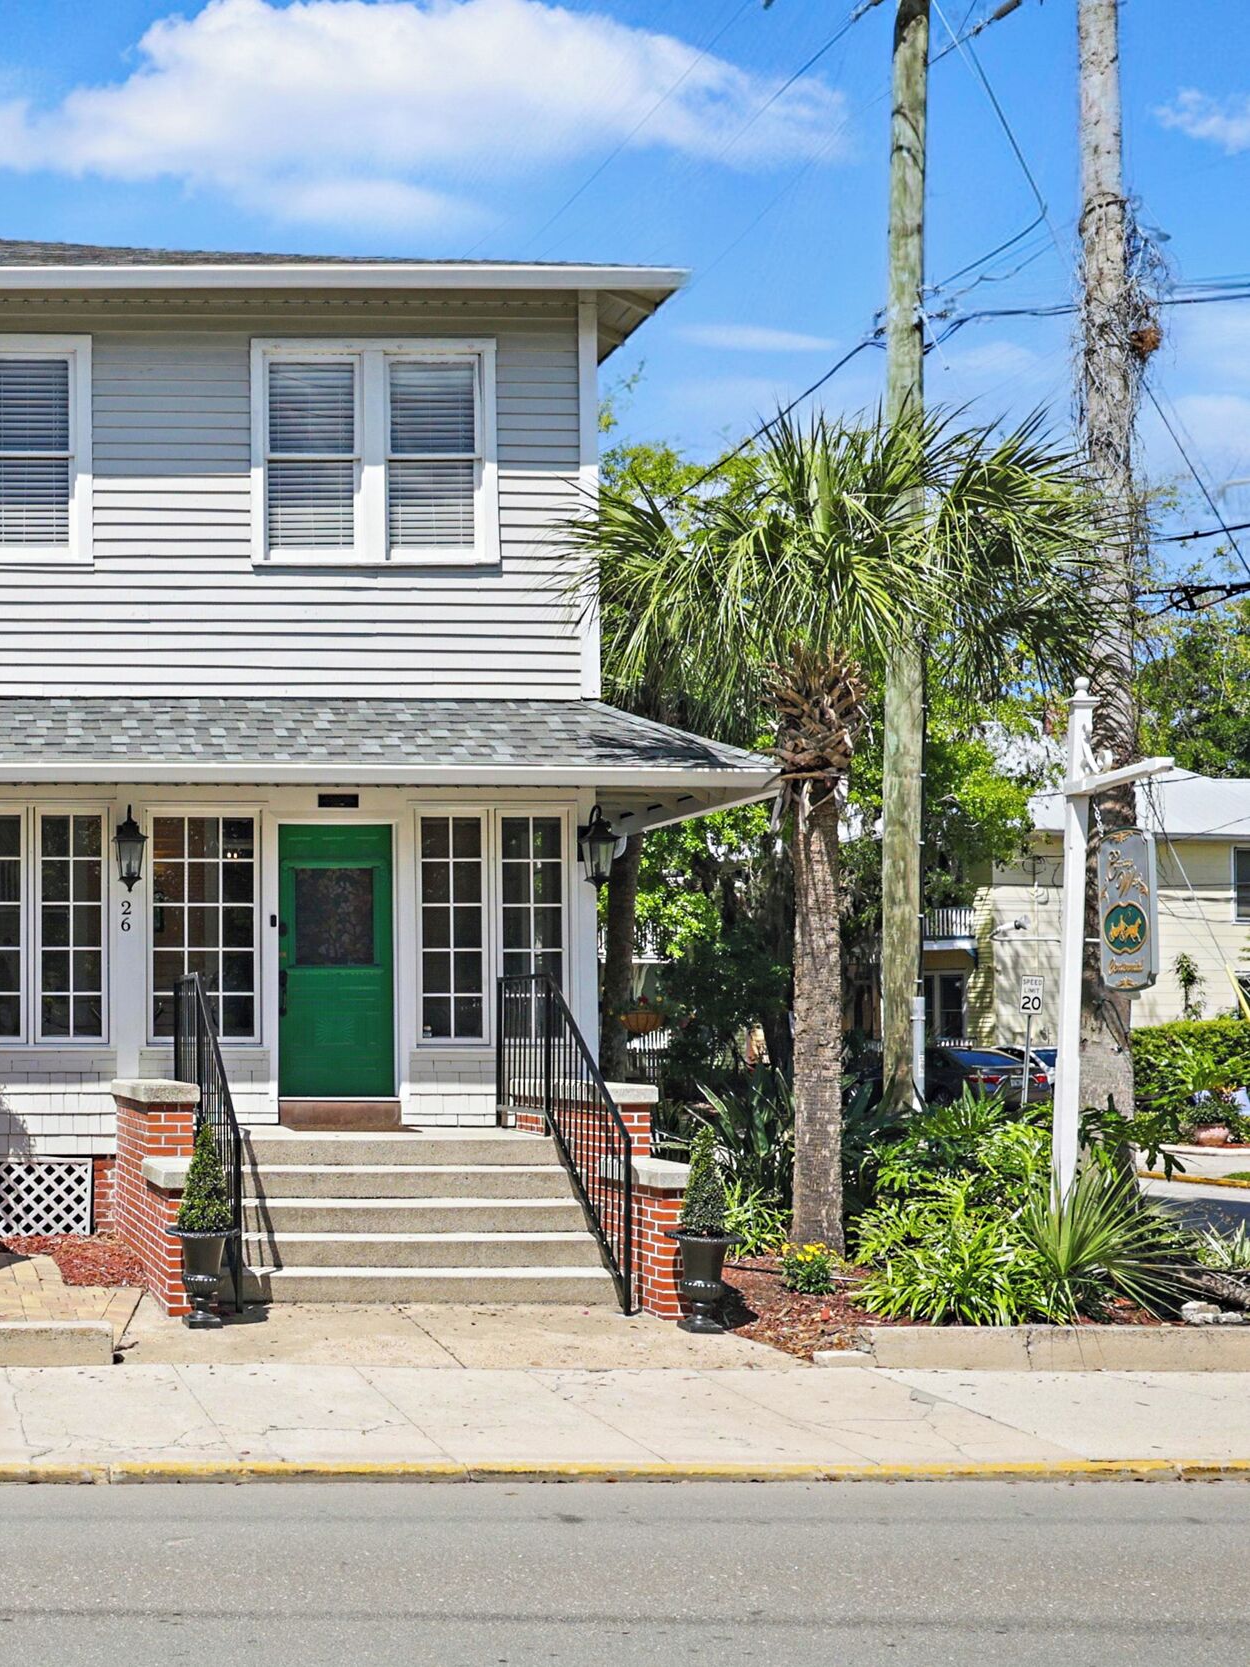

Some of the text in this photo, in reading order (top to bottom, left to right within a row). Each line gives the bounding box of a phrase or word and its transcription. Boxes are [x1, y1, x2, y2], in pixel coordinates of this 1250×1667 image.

[121, 900, 131, 932] 26
[1023, 978, 1042, 986] SPEED
[1021, 996, 1041, 1010] 20
